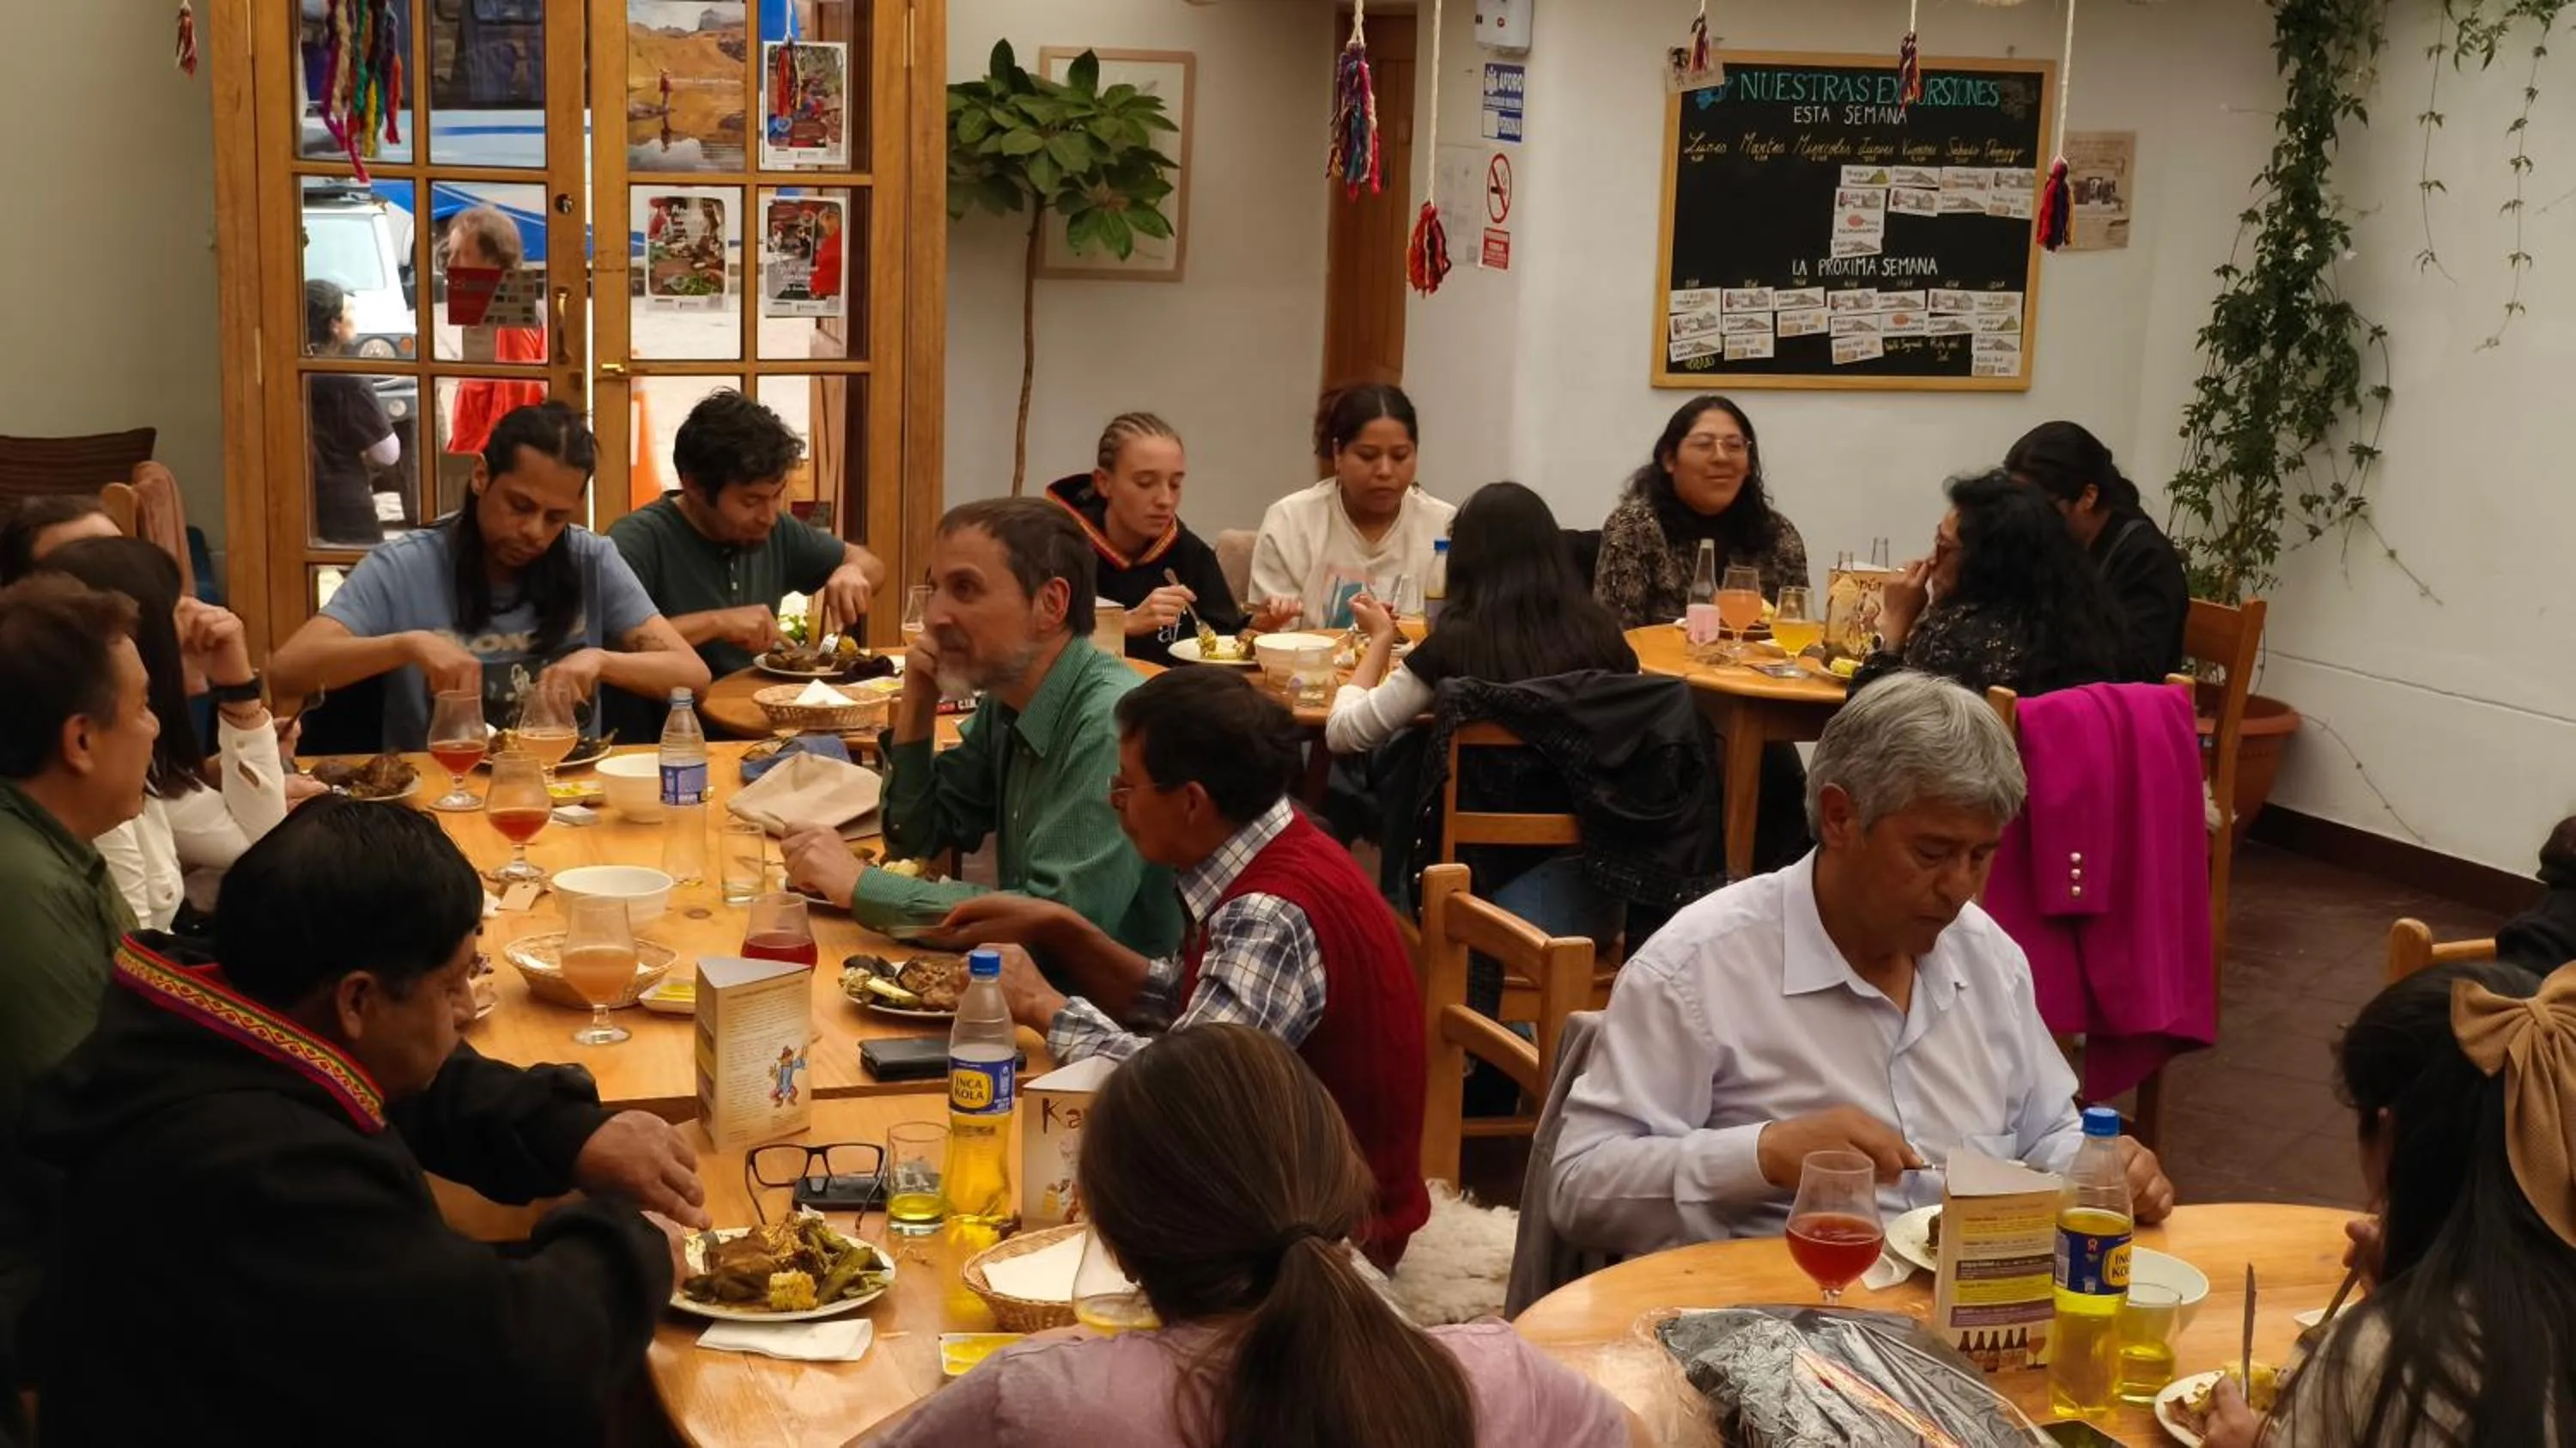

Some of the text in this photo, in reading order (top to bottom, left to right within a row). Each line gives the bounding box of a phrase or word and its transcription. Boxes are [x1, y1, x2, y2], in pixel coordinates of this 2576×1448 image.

[1741, 71, 2000, 106] NUESTRAS EXURSIONES
[1794, 104, 1907, 125] ESTA SEMANA
[1792, 259, 1807, 276] LA
[1881, 257, 1938, 277] SEMANA
[955, 1074, 983, 1088] INCA
[954, 1086, 985, 1100] KOLA
